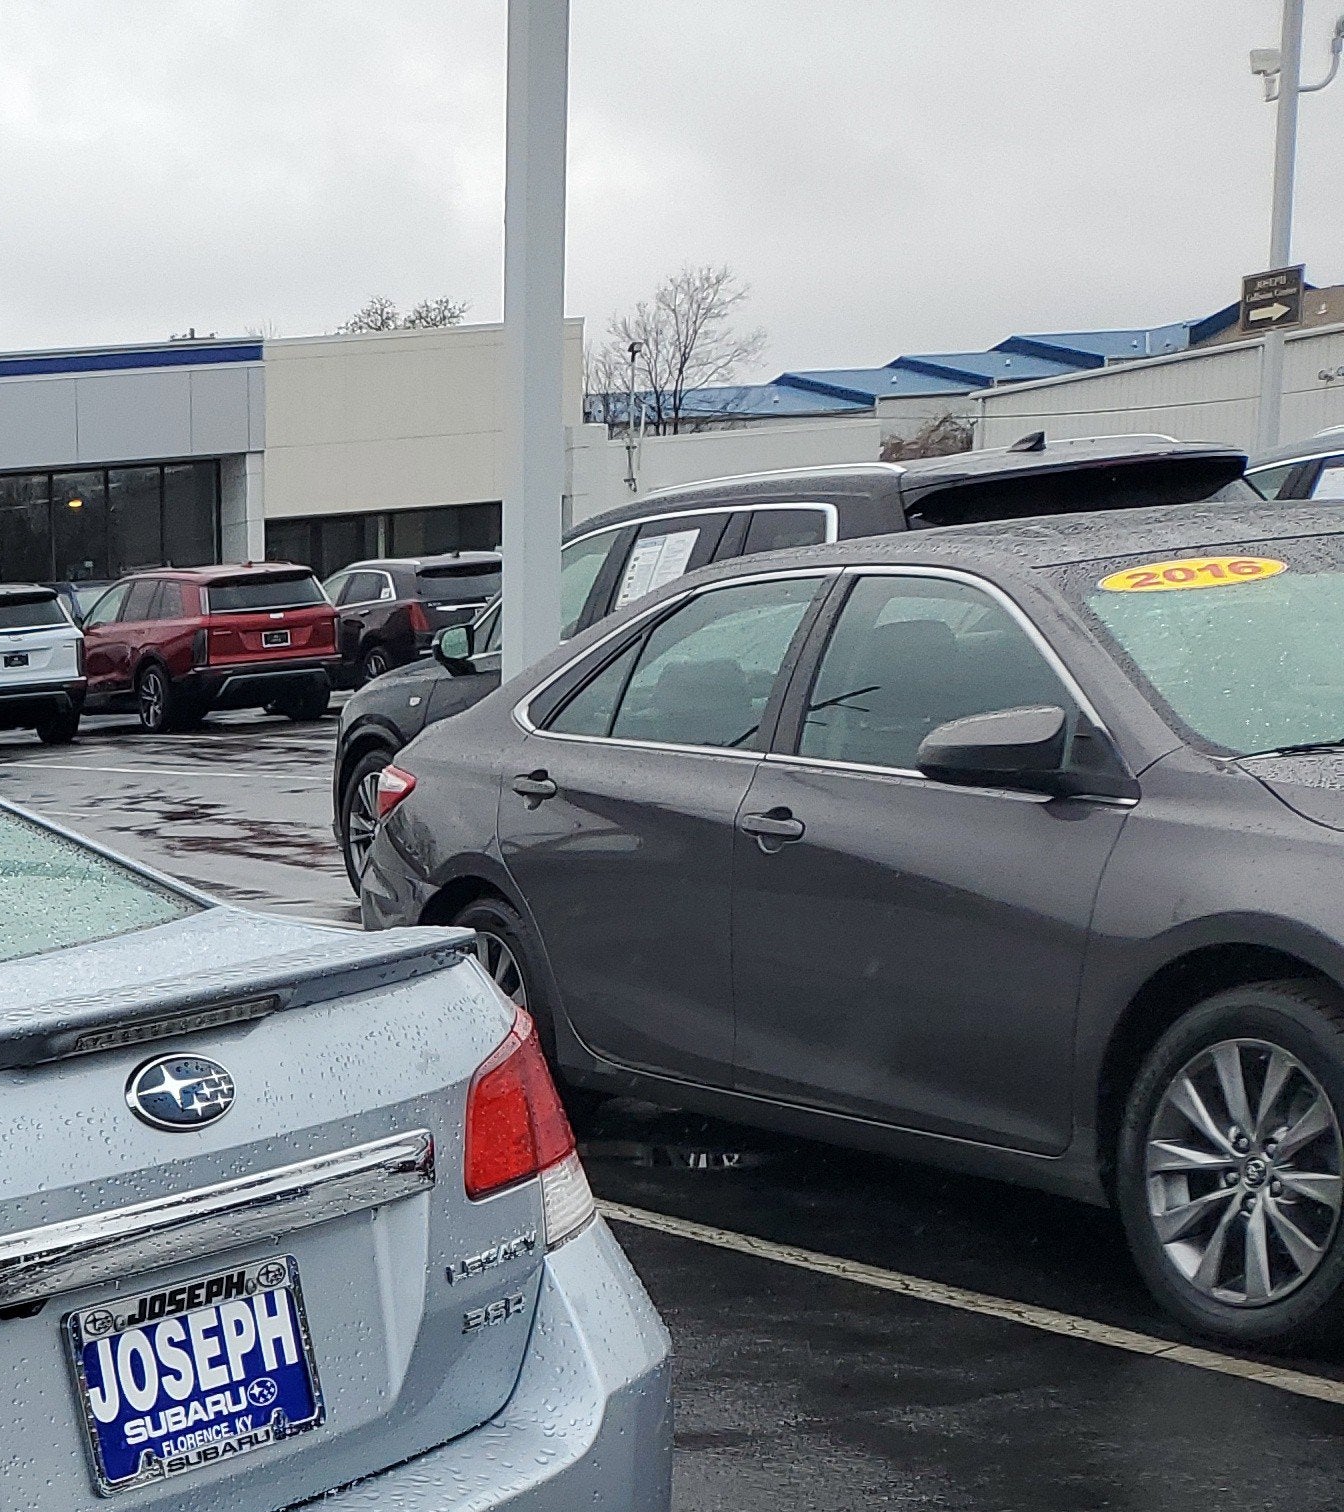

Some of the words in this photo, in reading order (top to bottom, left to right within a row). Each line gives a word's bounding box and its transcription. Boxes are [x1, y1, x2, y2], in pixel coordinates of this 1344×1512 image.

[1126, 560, 1264, 589] 2016
[126, 1270, 247, 1325] JOSEPH
[88, 1288, 299, 1423] JOSEPH
[124, 1386, 248, 1444] SUBARU
[234, 1414, 254, 1436] KY
[167, 1427, 271, 1474] SUBARU
